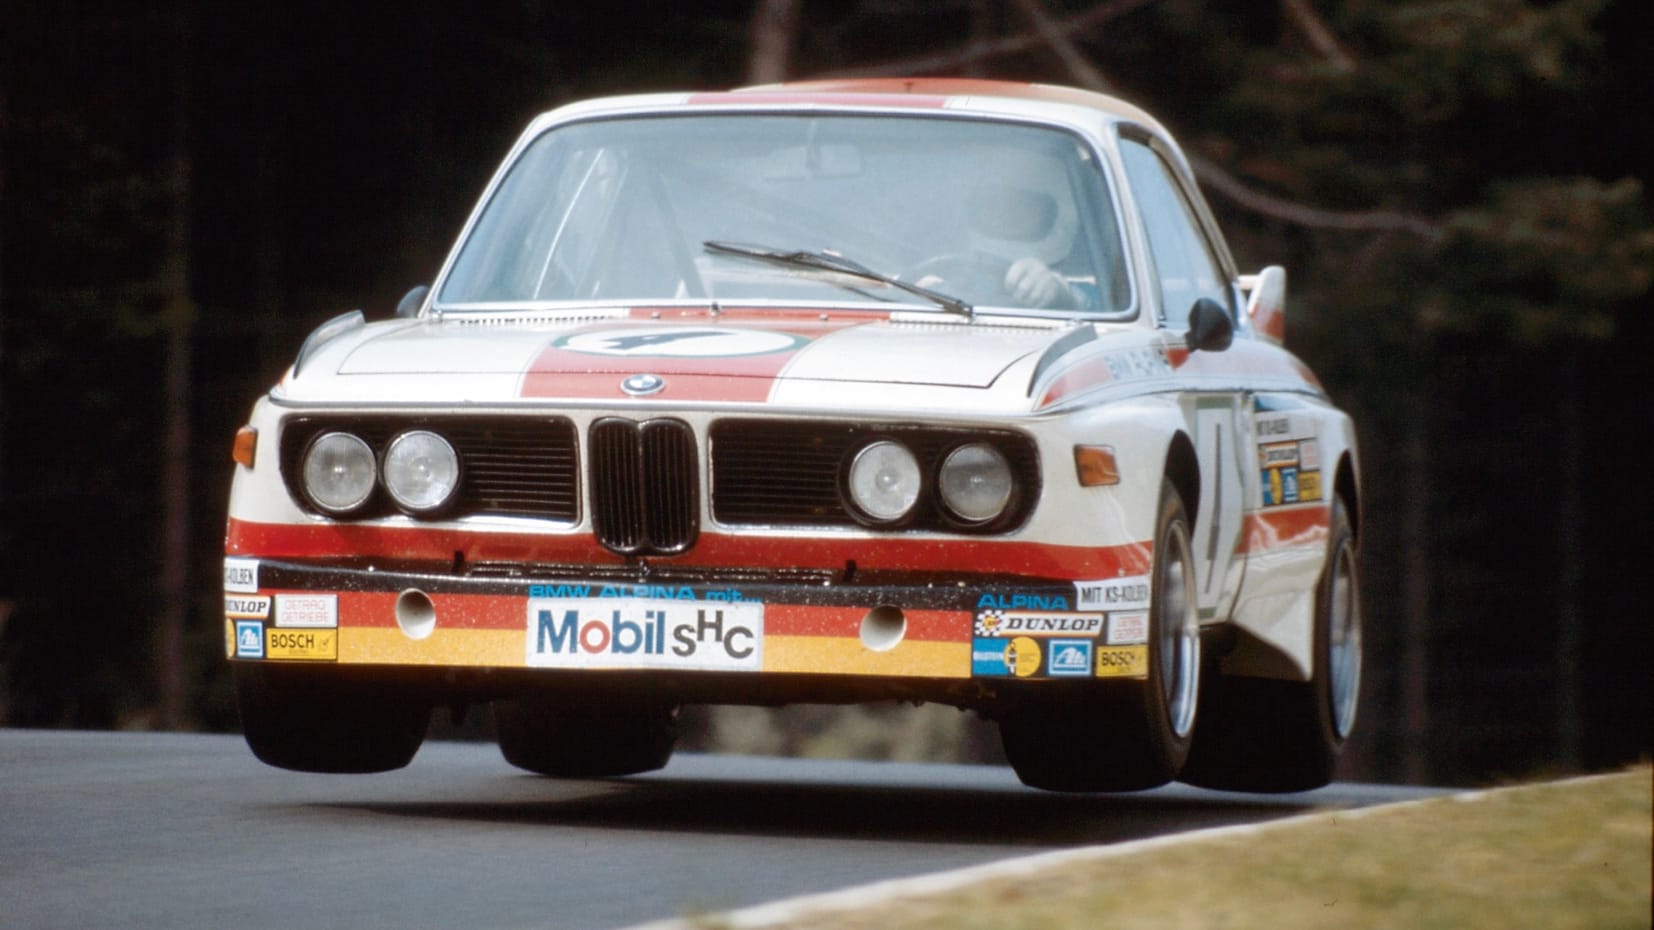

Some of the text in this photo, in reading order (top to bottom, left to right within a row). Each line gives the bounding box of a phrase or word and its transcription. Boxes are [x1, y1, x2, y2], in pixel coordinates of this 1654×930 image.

[529, 584, 591, 599] BMW
[600, 585, 696, 601] ALPINA
[1081, 586, 1103, 604] MIT
[977, 593, 1068, 610] ALPINA
[1006, 617, 1099, 632] DUNLOP
[271, 633, 315, 649] BOSCH
[536, 609, 755, 660] Mobil SHC
